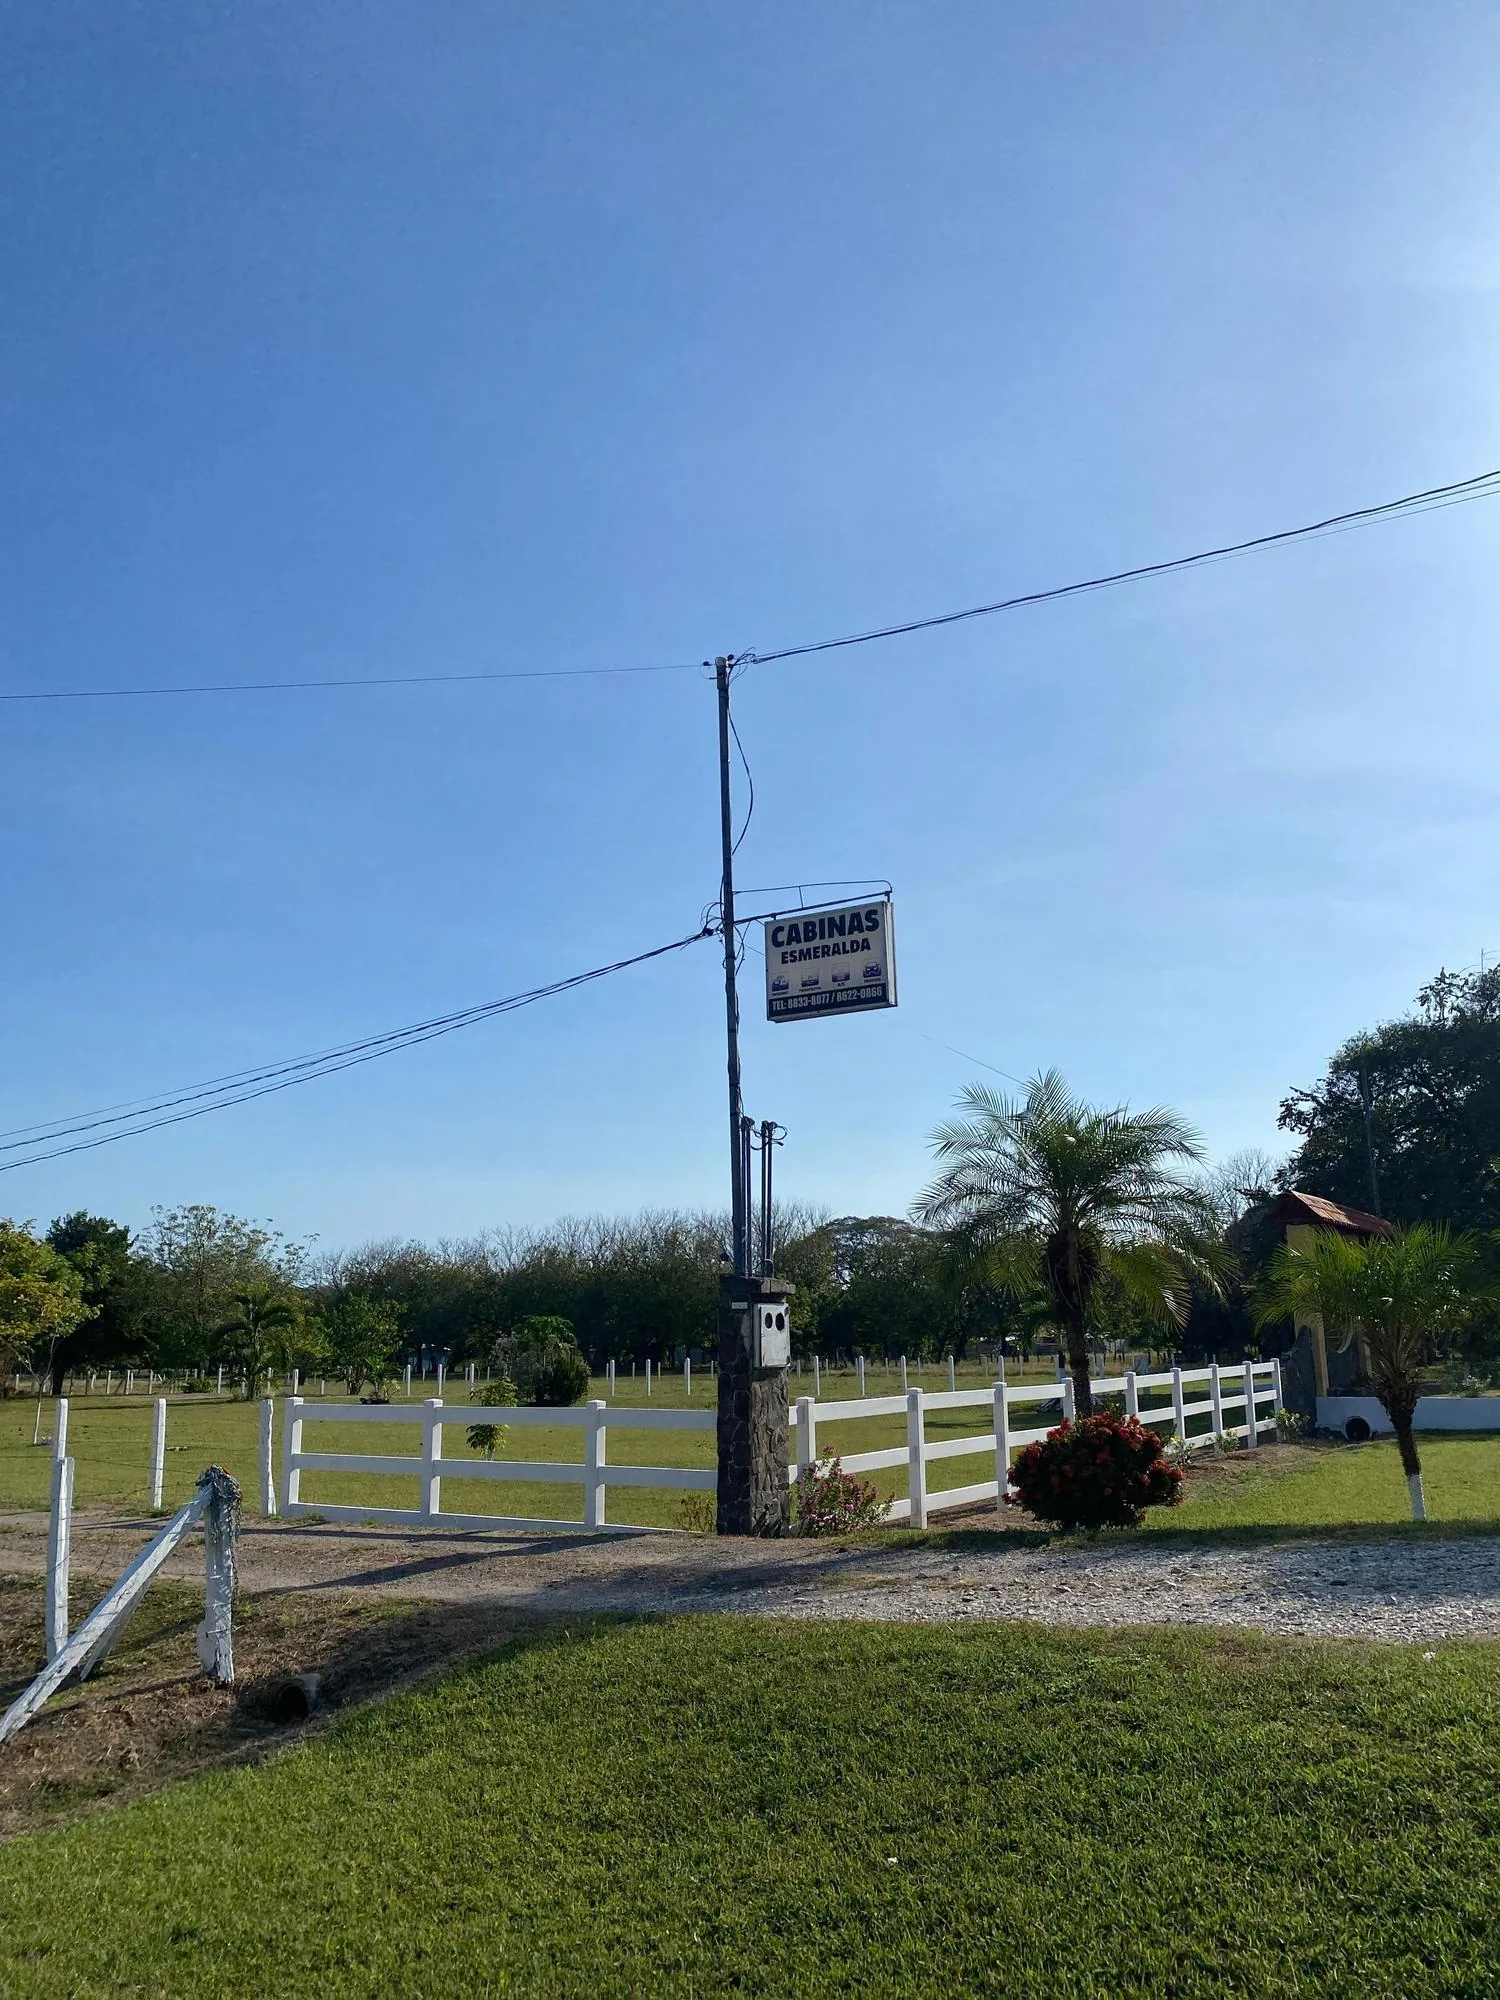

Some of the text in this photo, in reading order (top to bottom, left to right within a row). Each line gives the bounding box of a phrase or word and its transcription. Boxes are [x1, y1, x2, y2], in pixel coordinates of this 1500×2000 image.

[771, 909, 880, 948] CABINAS
[781, 938, 872, 965] ESMERALDA
[772, 1000, 787, 1011] TEL:
[831, 991, 835, 1003] /
